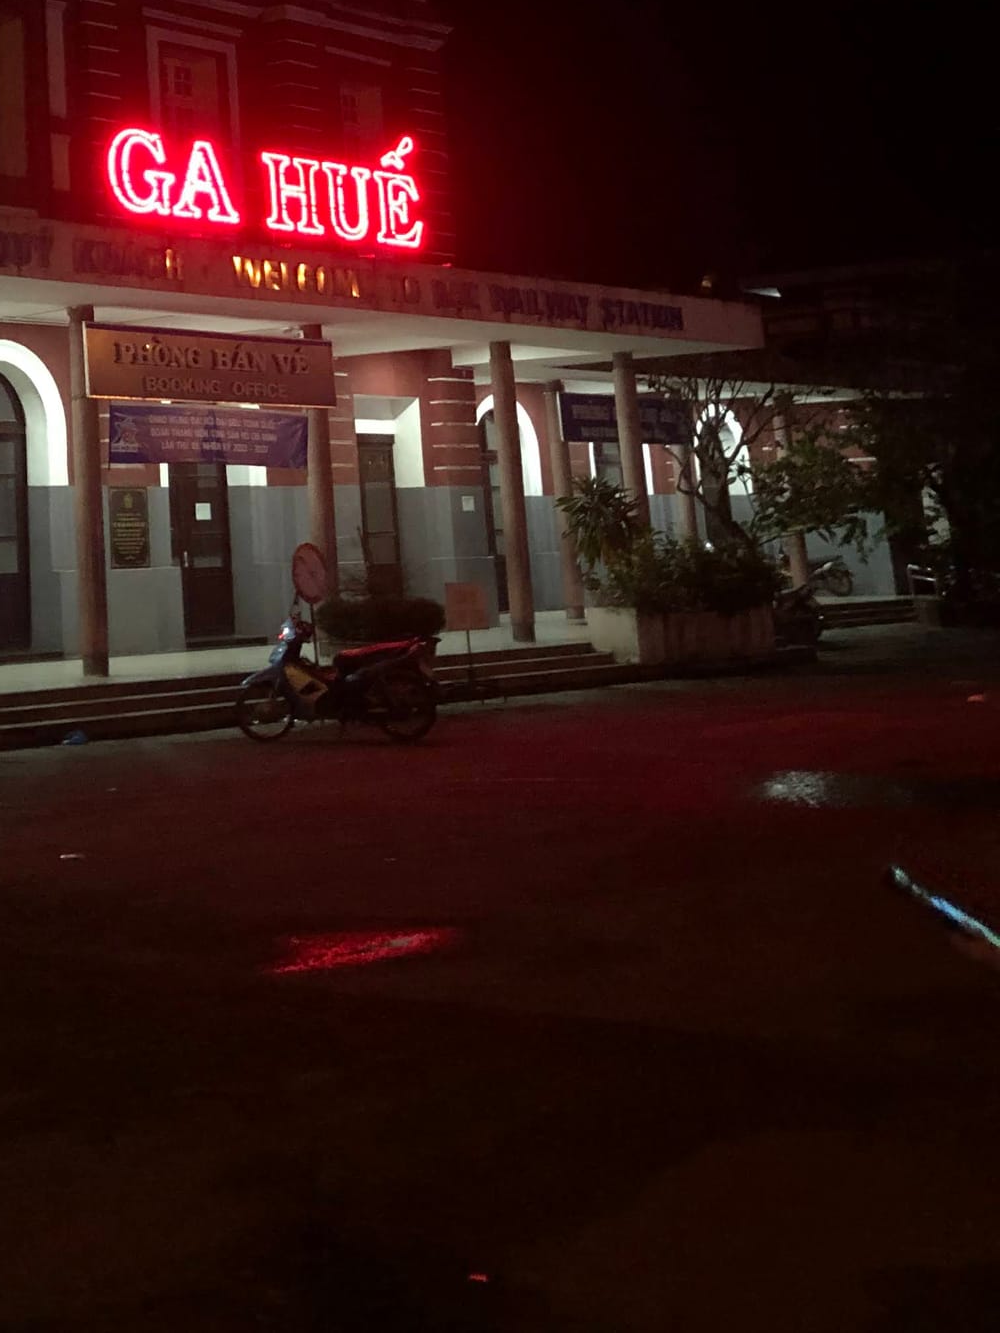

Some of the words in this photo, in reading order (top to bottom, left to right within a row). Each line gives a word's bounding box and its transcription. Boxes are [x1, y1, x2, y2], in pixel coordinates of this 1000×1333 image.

[108, 128, 240, 224] GA
[261, 136, 424, 248] HUẾ
[113, 336, 202, 368] PHÒNG
[211, 343, 268, 374] BÁN
[142, 375, 222, 395] BOOKING
[232, 380, 288, 398] OFFICE
